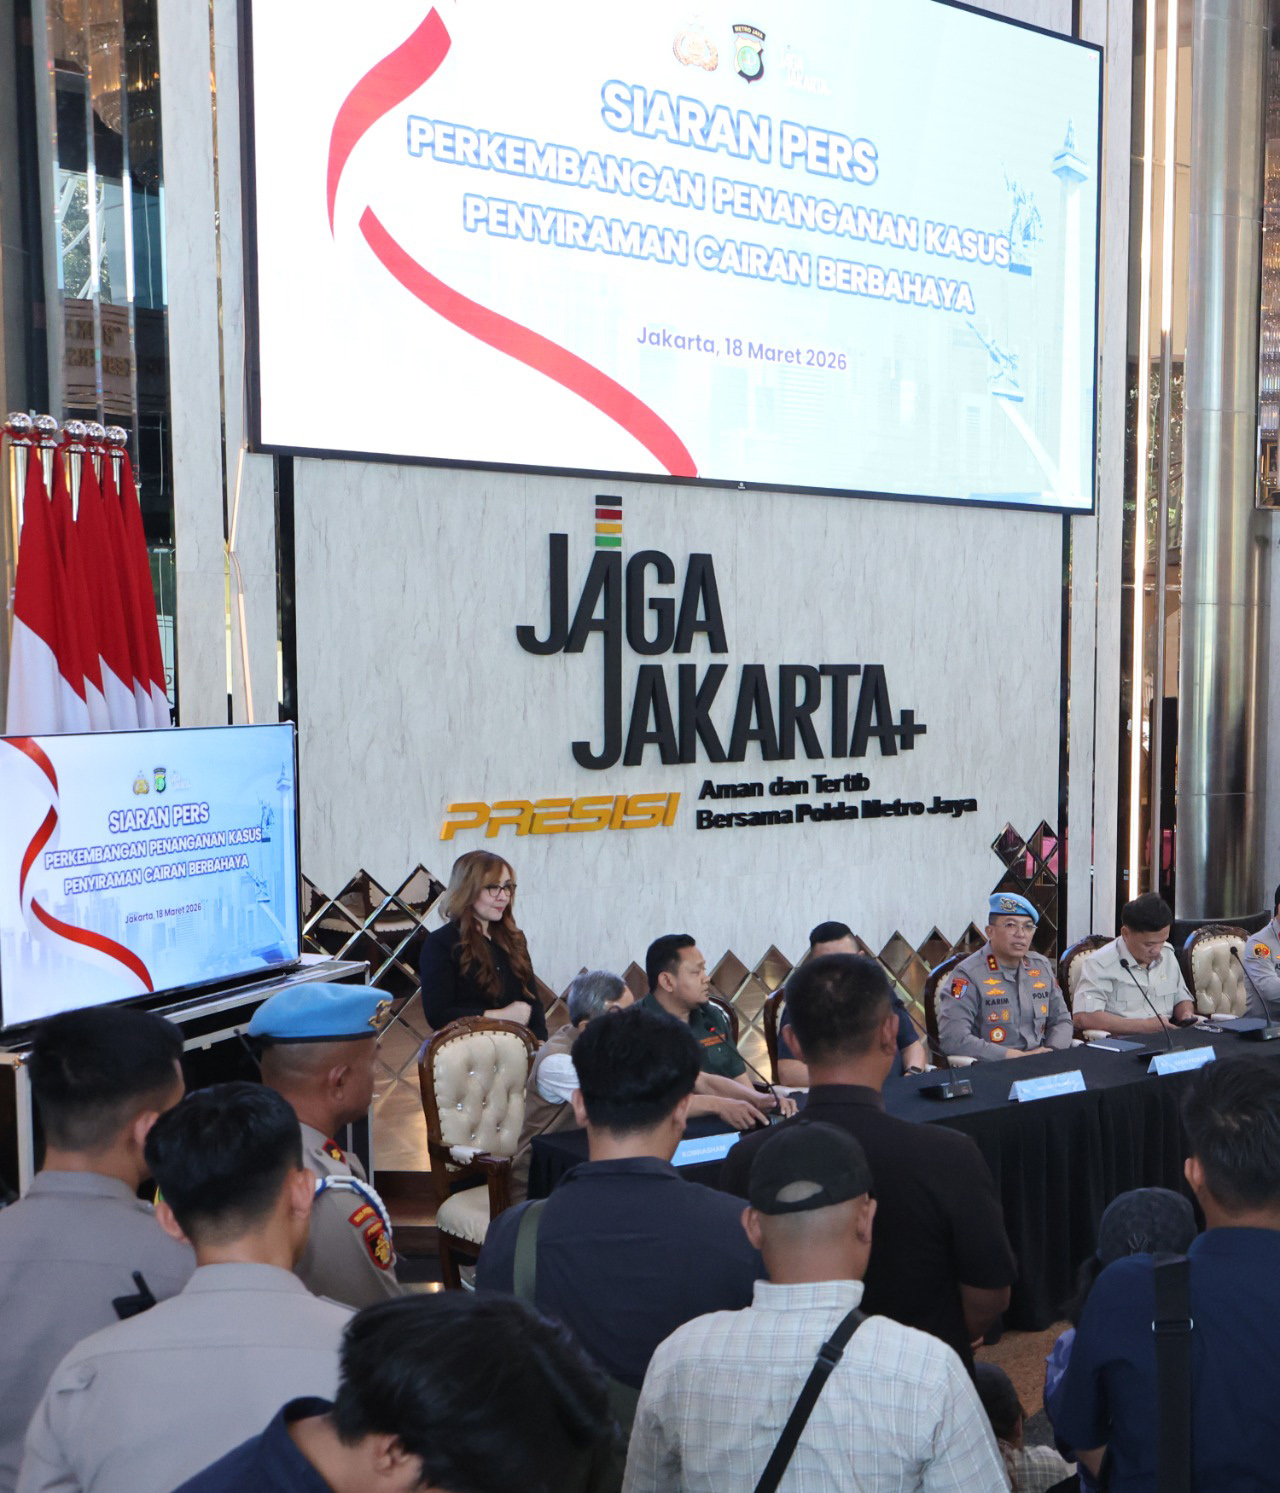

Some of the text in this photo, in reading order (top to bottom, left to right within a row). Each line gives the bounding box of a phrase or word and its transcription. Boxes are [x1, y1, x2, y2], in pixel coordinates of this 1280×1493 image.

[601, 79, 879, 185] SIARAN PERS
[407, 115, 1012, 267] PERKEMBANGAN PENANGANAN KASUS
[463, 193, 975, 314] PENYIRAMAN CAIRAN BERBAHAYA
[637, 327, 847, 370] Jakarta, 18 Maret 2026
[516, 532, 728, 656] JAGA
[698, 773, 871, 800] Aman dan Tertib
[108, 802, 210, 834] SIARAN PERS
[440, 792, 681, 841] PRESISI
[696, 796, 978, 830] Bersama Polda Metro Jaya
[44, 827, 262, 870] PERKEMBANGAN PENANGANAN KASUS
[64, 853, 250, 895] PENYIRAMAN CAIRAN BERBAHAYA
[125, 903, 202, 924] Jakarta, 18 Maret 2026
[985, 997, 1010, 1006] KARIM
